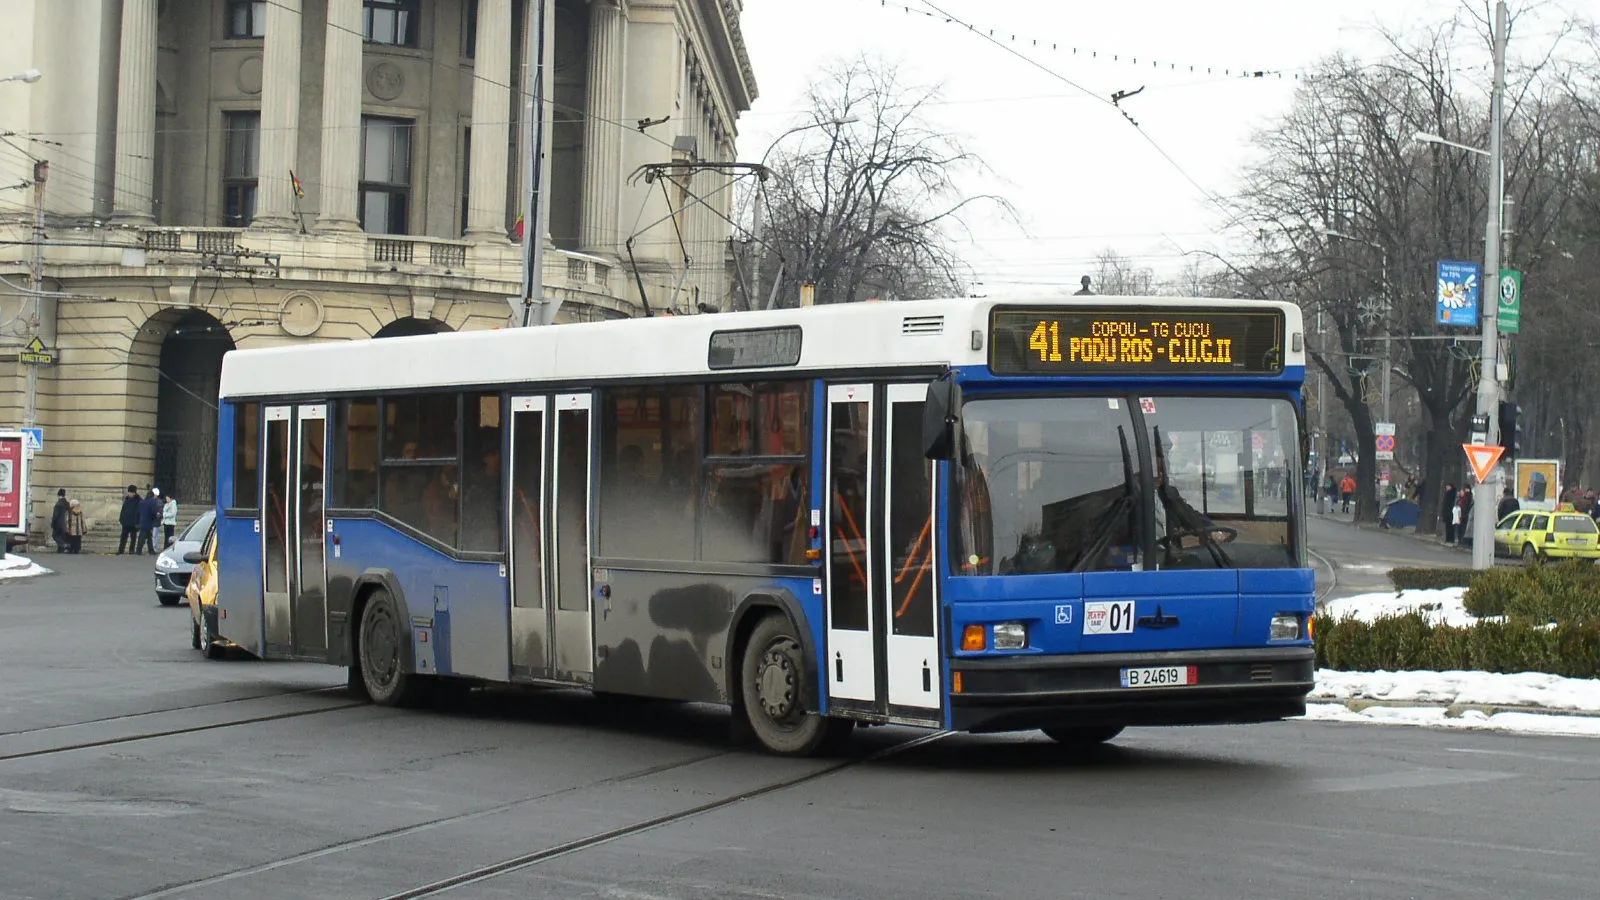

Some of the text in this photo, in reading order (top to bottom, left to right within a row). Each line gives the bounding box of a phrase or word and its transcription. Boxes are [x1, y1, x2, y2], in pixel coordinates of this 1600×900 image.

[1029, 320, 1062, 361] 41
[1174, 322, 1210, 338] CUCU
[22, 353, 51, 363] METRO
[1070, 337, 1117, 362] PODU
[1120, 338, 1153, 362] ROS
[1168, 338, 1232, 363] C.U.G.II
[1110, 602, 1132, 631] 01
[1129, 668, 1178, 685] B 24619
